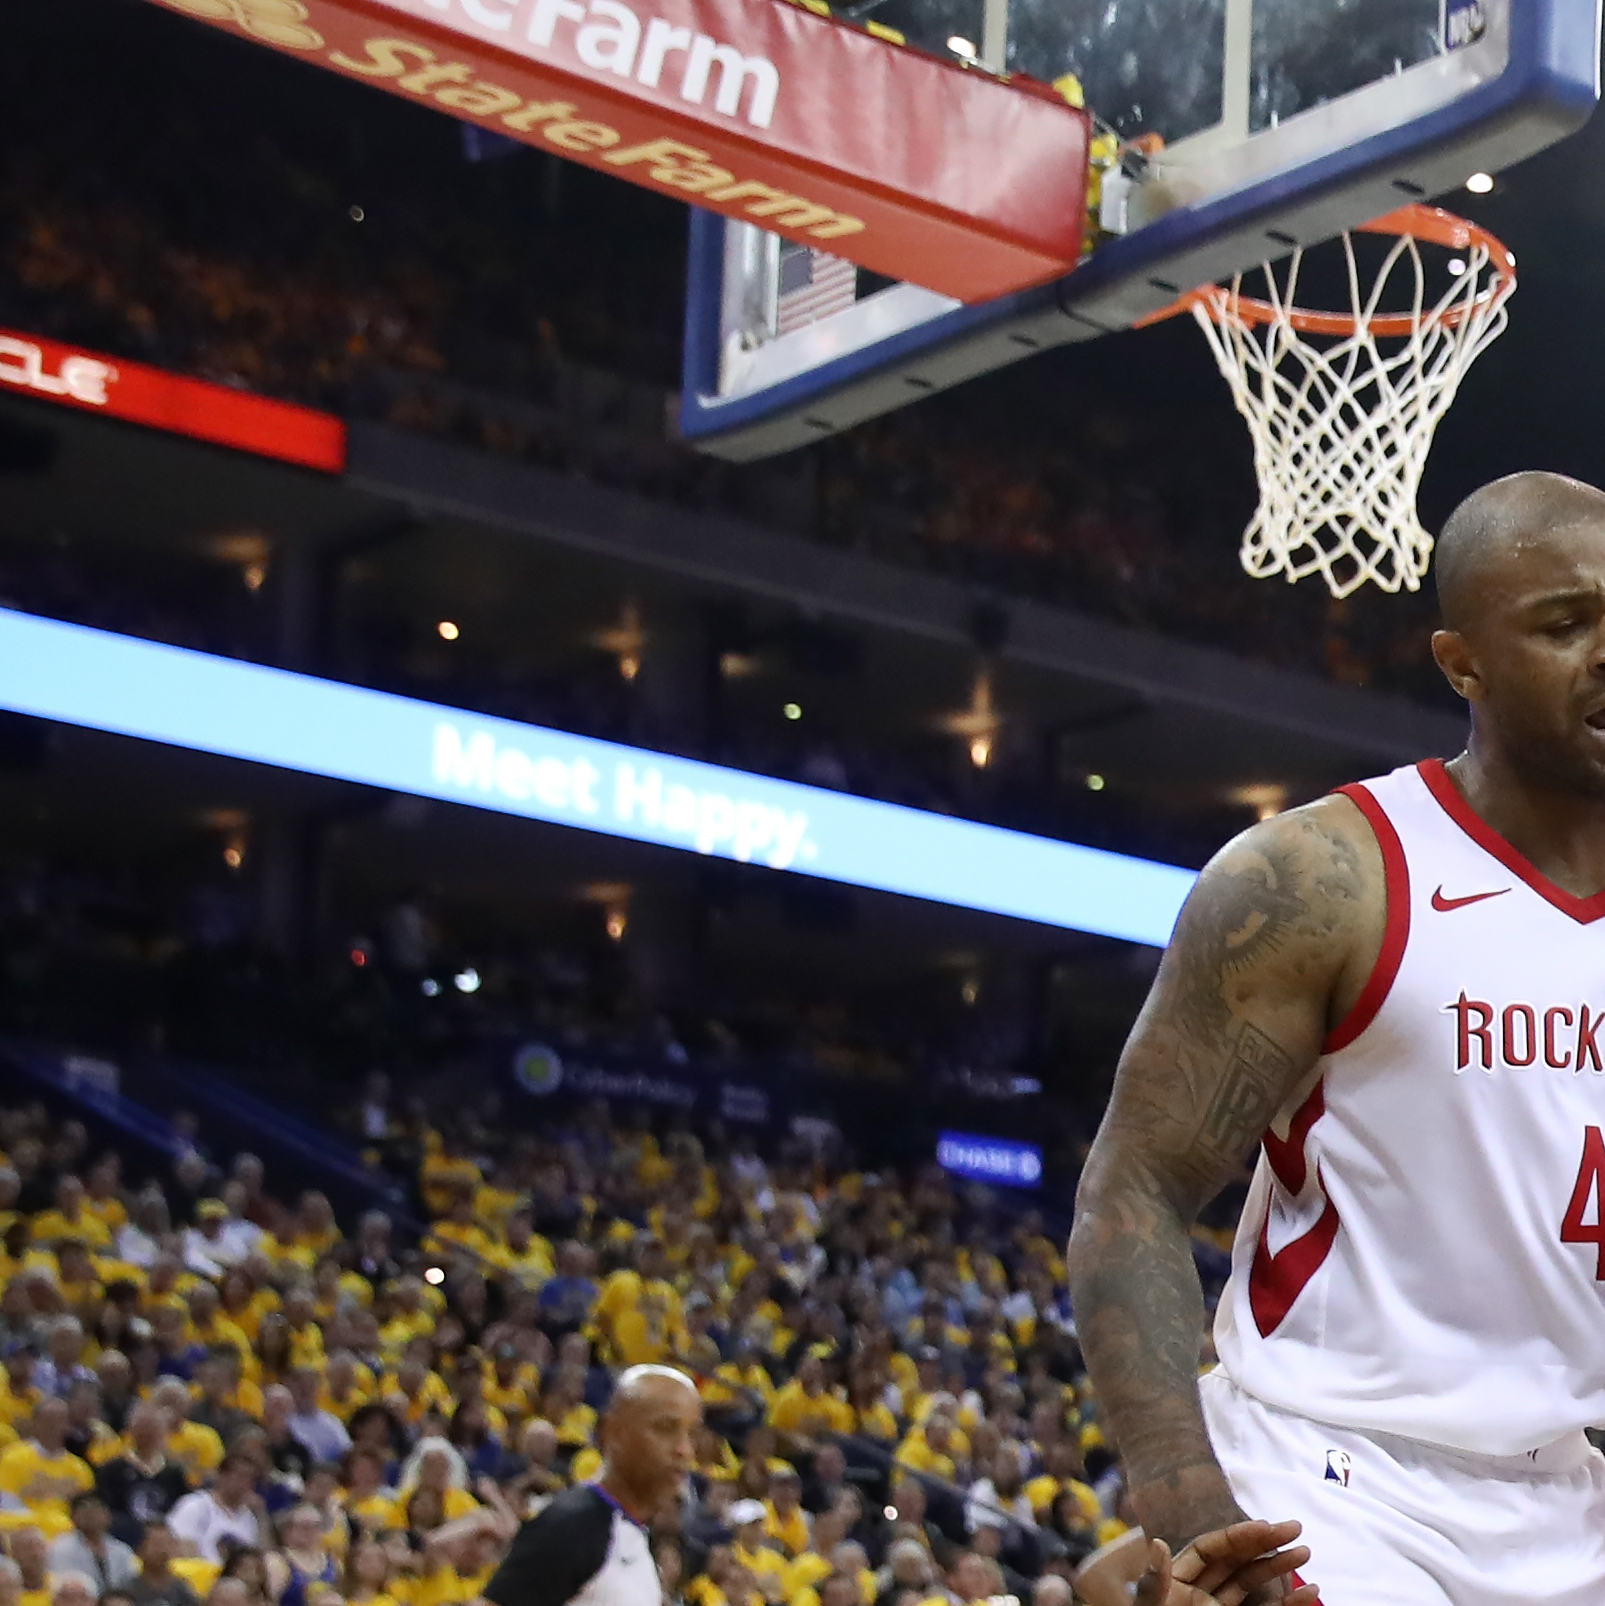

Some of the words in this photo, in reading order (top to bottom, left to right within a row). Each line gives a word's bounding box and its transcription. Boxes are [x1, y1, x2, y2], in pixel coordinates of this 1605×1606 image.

[329, 38, 621, 152] State
[604, 137, 867, 239] Farm
[433, 722, 600, 815] Meet
[613, 760, 819, 871] Happy.
